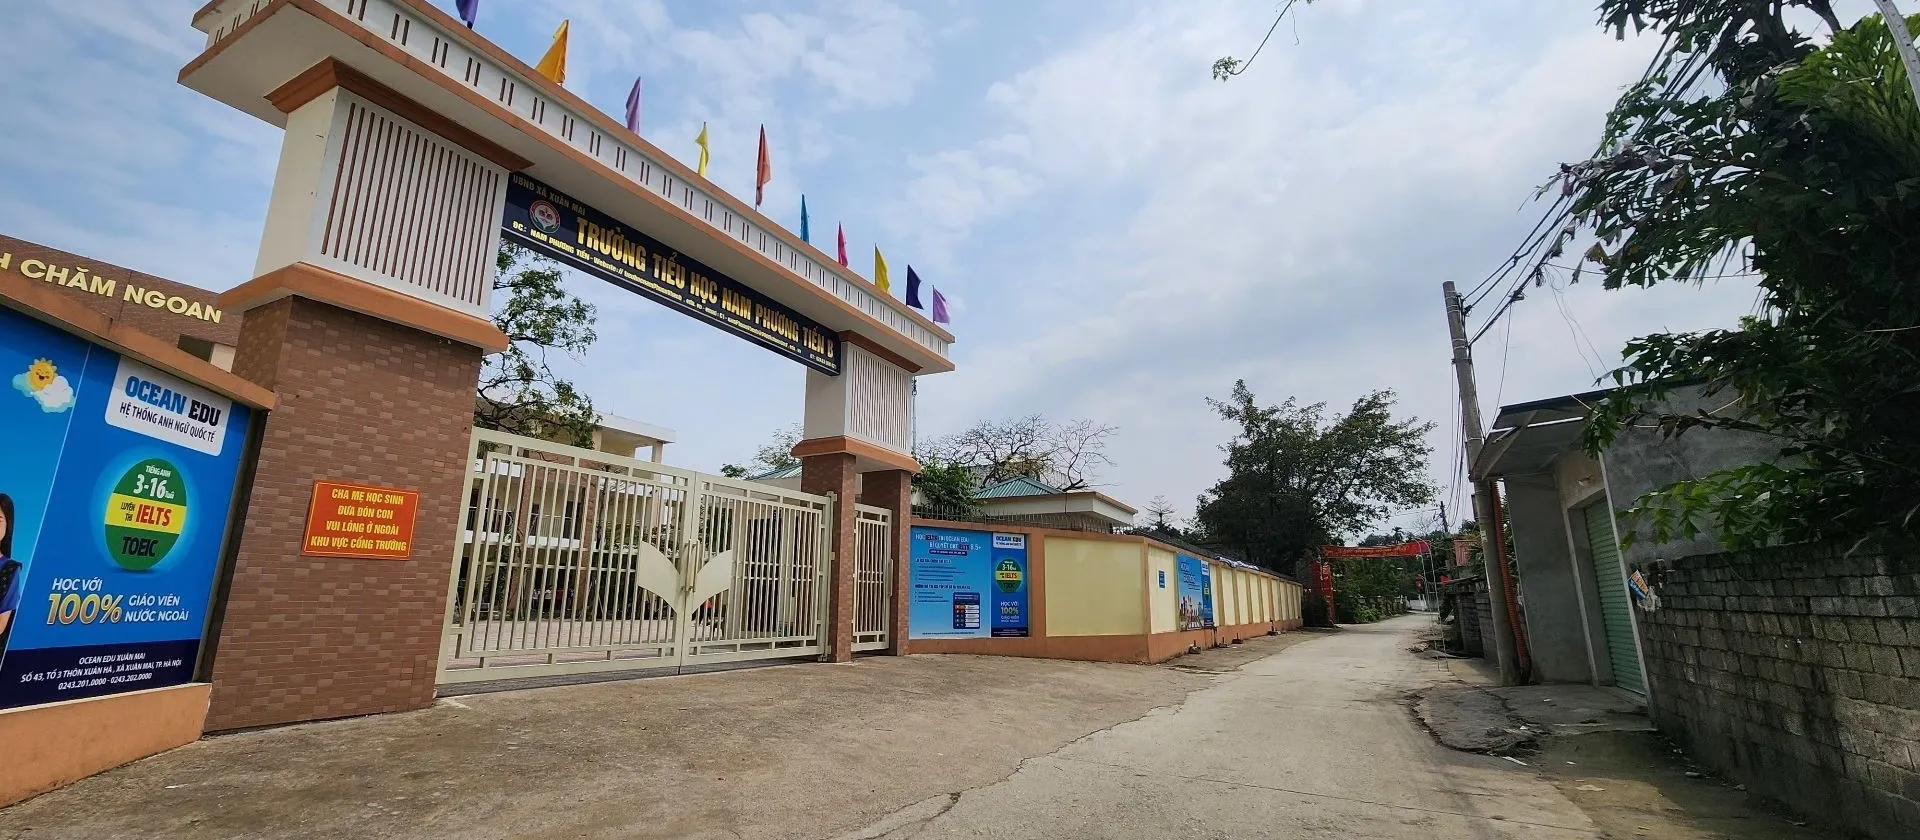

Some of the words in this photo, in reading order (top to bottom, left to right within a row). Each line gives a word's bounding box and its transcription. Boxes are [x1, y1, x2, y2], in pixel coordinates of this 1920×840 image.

[513, 174, 535, 191] UBND
[571, 202, 586, 216] MAI
[530, 228, 548, 242] NAM
[548, 236, 574, 254] PHƯƠNG
[20, 259, 117, 298] CHĂM
[122, 284, 222, 324] NGOAN
[577, 216, 646, 272] TRƯỜNG
[652, 251, 686, 290] TIỂU
[689, 271, 718, 304] HỌC
[721, 287, 752, 320] NAM
[755, 303, 799, 343] PHƯƠNG
[802, 325, 825, 355] TIẾN
[827, 338, 834, 358] B
[125, 375, 187, 415] OCEAN
[188, 399, 221, 427] EDU
[119, 402, 132, 418] HỆ
[132, 406, 158, 424] THỐNG
[158, 415, 174, 430] ANH
[174, 419, 190, 434] NGỮ
[189, 426, 208, 441] QUỐC
[206, 430, 216, 443] TẾ
[160, 468, 172, 477] ANH
[133, 474, 167, 499] 3-16
[331, 488, 349, 500] CHA
[351, 490, 366, 503] MẸ
[366, 492, 383, 504] HỌC
[384, 494, 404, 505] SINH
[135, 503, 172, 527] IELTS
[337, 505, 355, 516] ĐƯA
[356, 505, 375, 518] ĐÓN
[376, 508, 394, 520] CON
[326, 520, 341, 531] VUI
[341, 520, 365, 532] LÒNG
[374, 523, 399, 535] NGOÀI
[121, 536, 159, 557] TOEIC
[310, 535, 330, 547] KHU
[331, 536, 349, 549] VỰC
[350, 535, 374, 550] CỔNG
[375, 538, 407, 551] TRƯỜNG
[52, 578, 81, 593] HỌC
[82, 576, 102, 591] VỚI
[46, 593, 123, 625] 100%
[128, 593, 155, 606] GIÁO
[157, 594, 180, 606] VIÊN
[125, 609, 157, 622] NƯỚC
[157, 609, 189, 621] NGOÀI
[1001, 607, 1019, 615] 100%
[79, 655, 102, 664] OCEAN
[102, 654, 117, 663] EDU
[116, 652, 134, 661] XUÂN
[134, 652, 146, 660] MAI
[20, 671, 34, 683] SỐ
[57, 671, 62, 679] 3
[63, 668, 84, 678] THÔN
[83, 666, 103, 676] XUÂN
[125, 662, 142, 672] XUÂN
[57, 677, 107, 691] 0243.201.0000
